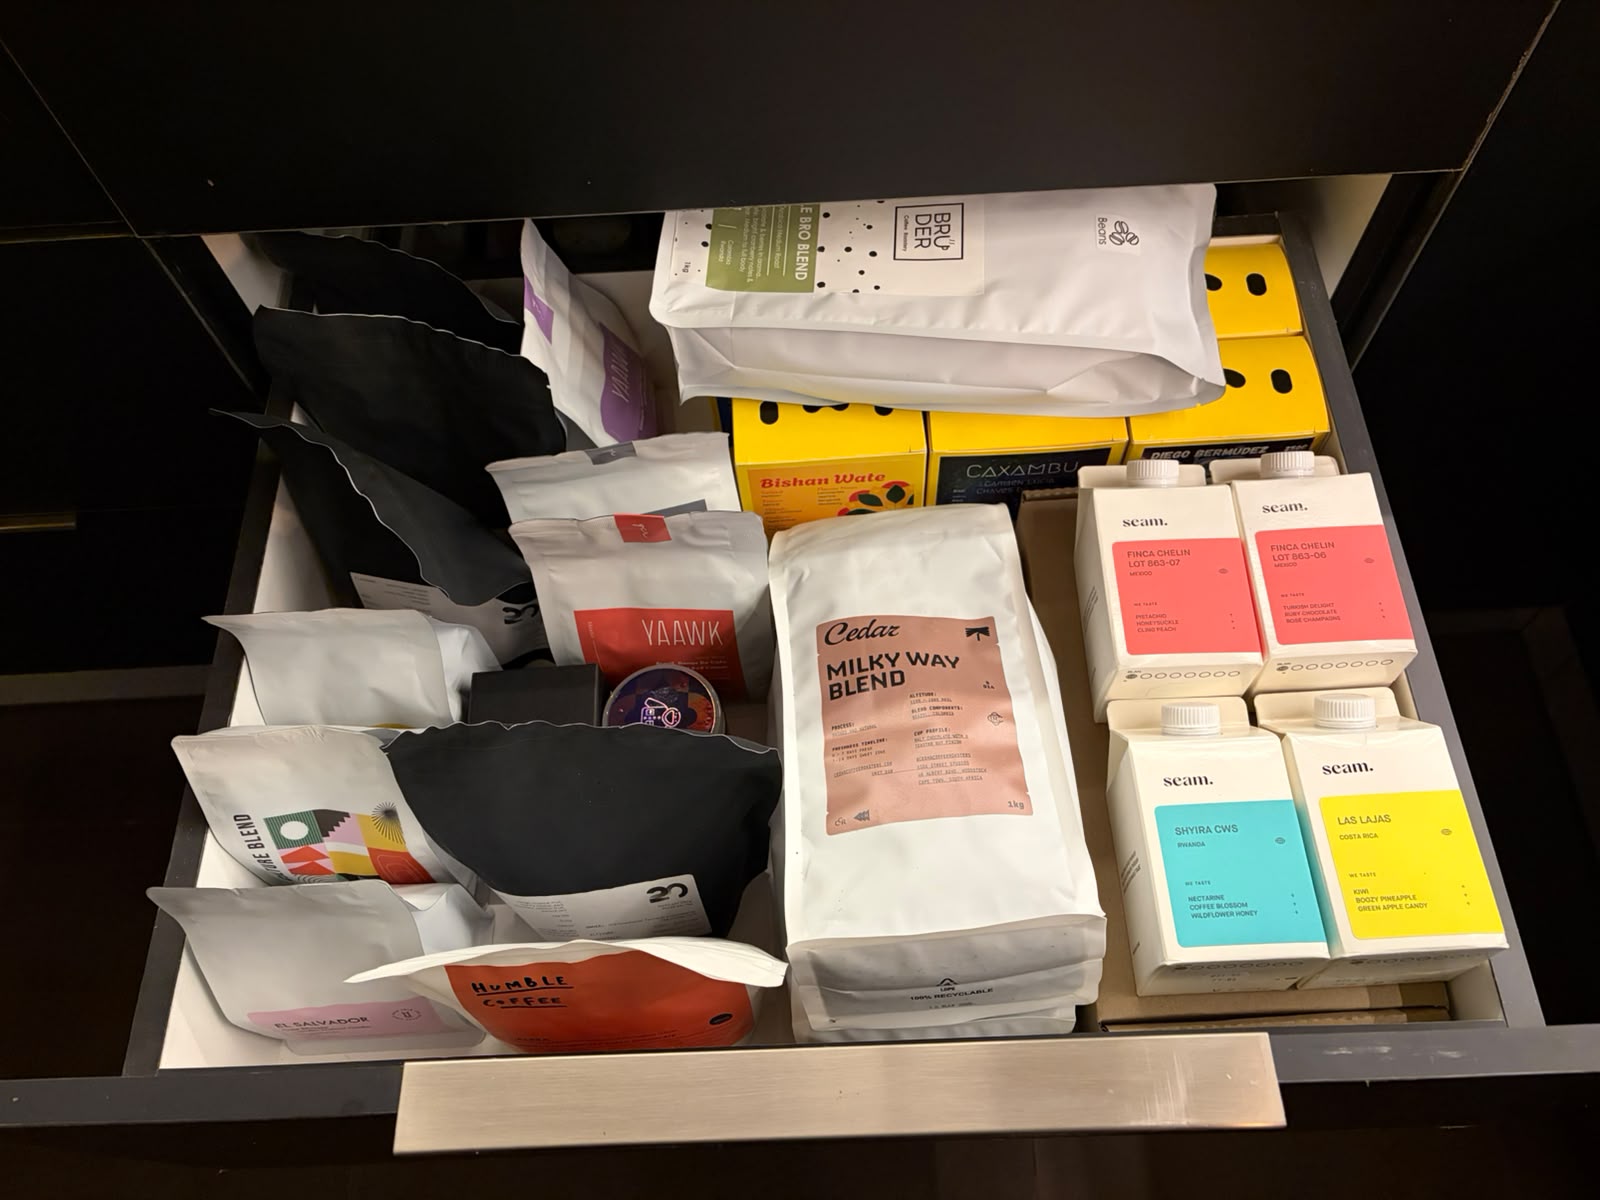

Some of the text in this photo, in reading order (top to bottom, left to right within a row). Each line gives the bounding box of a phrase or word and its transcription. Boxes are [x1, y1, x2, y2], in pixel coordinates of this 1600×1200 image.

[914, 213, 932, 248] DER
[933, 212, 951, 250] BRU
[1097, 217, 1108, 245] Beans
[795, 204, 812, 281] E BRO BLEND
[738, 257, 747, 272] body
[774, 253, 782, 269] Roast
[682, 262, 691, 273] 1kg
[747, 261, 755, 278] notes
[1151, 450, 1191, 460] DIEGO
[966, 461, 1078, 479] CAXAMBU
[760, 473, 886, 489] Bishan Wate
[1262, 502, 1308, 513] seam.
[1122, 517, 1168, 528] seam.
[1270, 541, 1335, 552] FINCA CHELIN
[1127, 549, 1191, 558] FINCA CHELIN
[1272, 551, 1327, 562] LOT 863-06
[1128, 559, 1180, 568] LOT 863-07
[641, 619, 723, 646] YAAWK
[824, 619, 901, 646] Cedar
[826, 651, 960, 681] MILKY WAY
[828, 669, 906, 701] BLEND
[831, 722, 855, 730] PROCESS:
[1322, 762, 1374, 775] seam.
[1163, 775, 1214, 787] seam.
[1007, 800, 1025, 810] 1kg
[1337, 814, 1391, 825] LAS LAJAS
[233, 814, 265, 849] BLEND
[1174, 824, 1239, 835] SHYIRA CWS
[1188, 894, 1225, 902] NECTARINE
[1380, 894, 1417, 902] PINEAPPLE
[1191, 909, 1258, 919] WILDFLOWER HONEY
[471, 975, 568, 993] HUMBLE
[934, 988, 994, 998] RECYCLABLE
[482, 997, 561, 1008] COFFEE
[295, 1016, 370, 1028] SALVADOR
